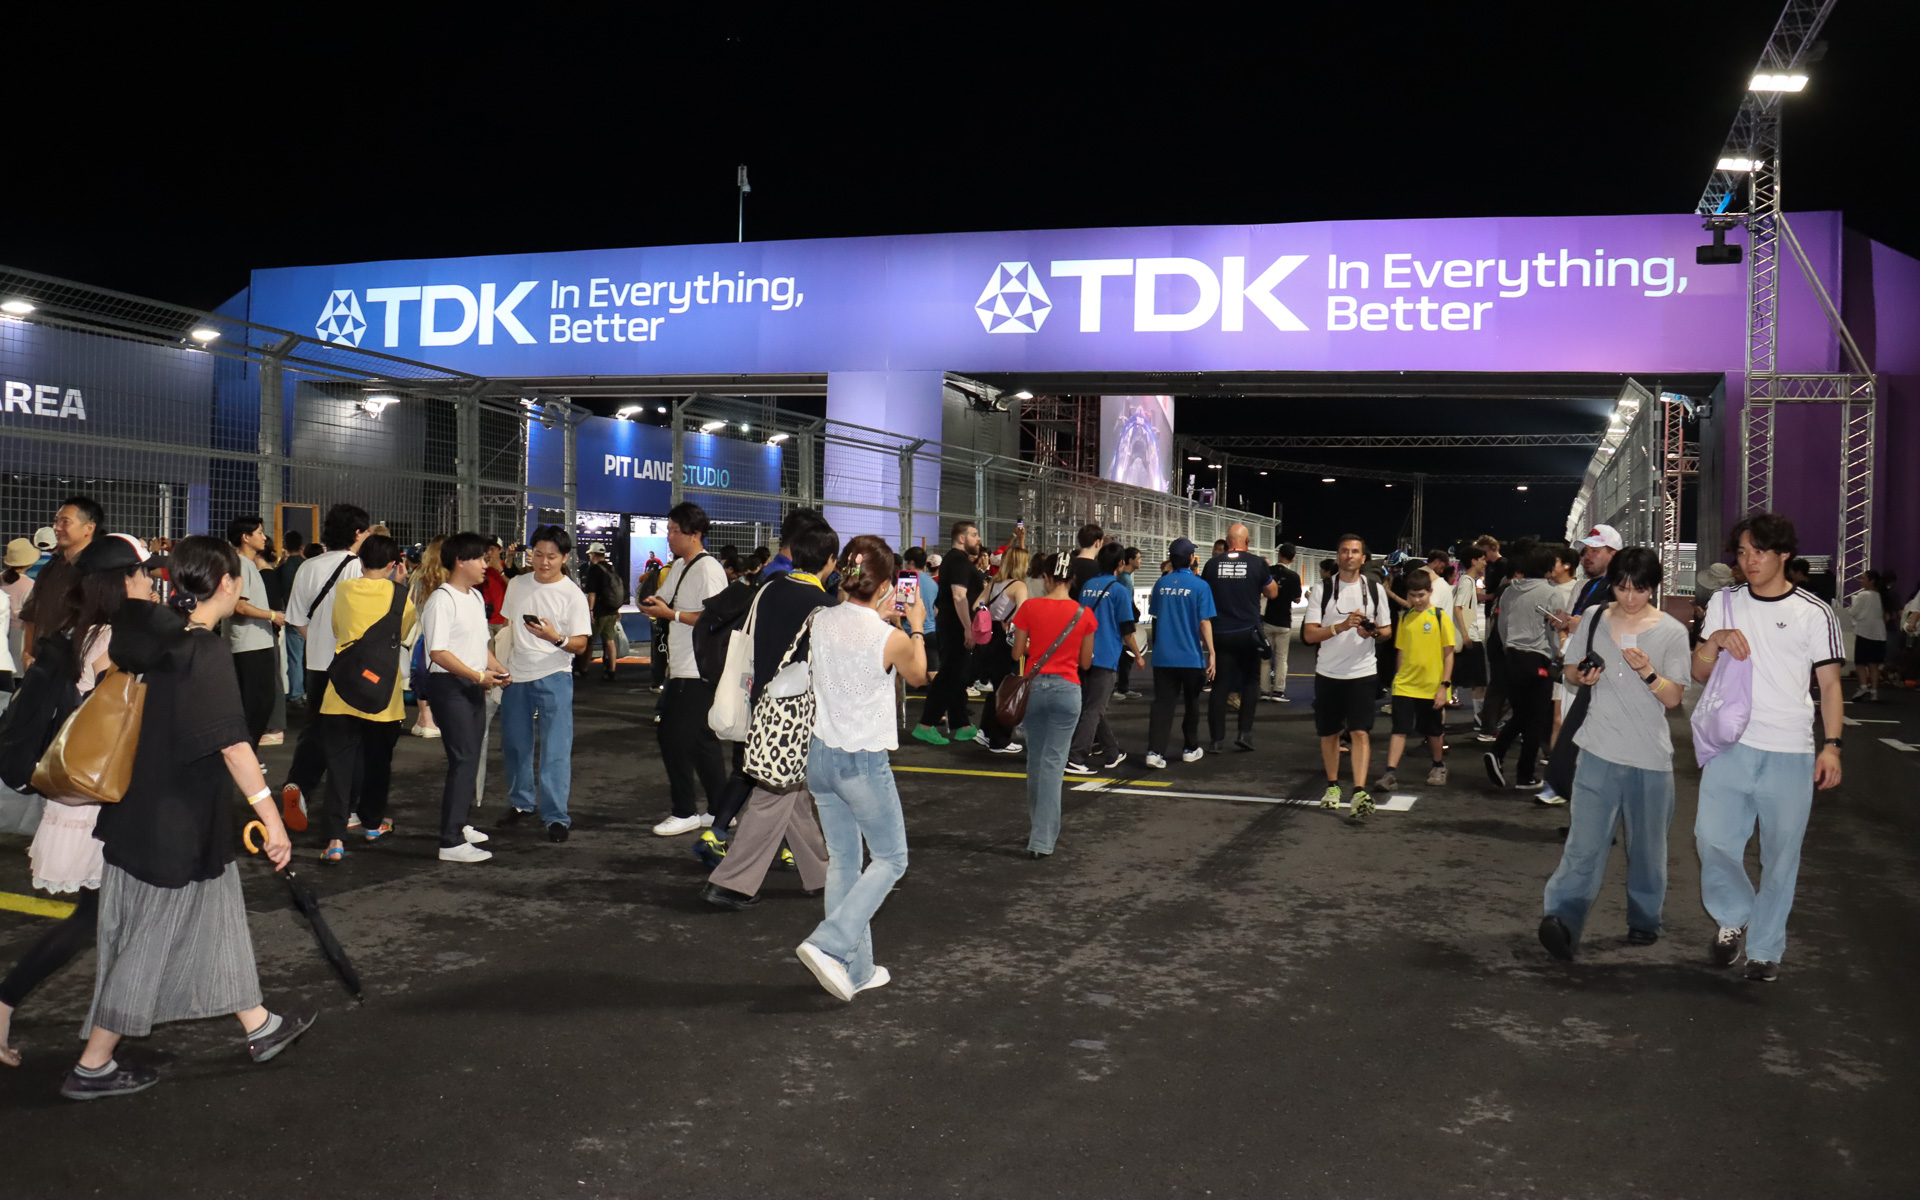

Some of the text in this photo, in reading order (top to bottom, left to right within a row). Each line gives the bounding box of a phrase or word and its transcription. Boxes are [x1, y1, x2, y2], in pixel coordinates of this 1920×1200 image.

[550, 270, 804, 312] In Everything,
[1327, 248, 1688, 298] In Everything,
[1050, 254, 1311, 333] TDK
[366, 281, 539, 348] TDK
[549, 313, 665, 344] Better
[1326, 295, 1494, 333] Better
[0, 380, 87, 420] REA
[604, 454, 632, 477] PIT
[1082, 589, 1110, 598] STAFF
[1159, 587, 1191, 597] STAFF
